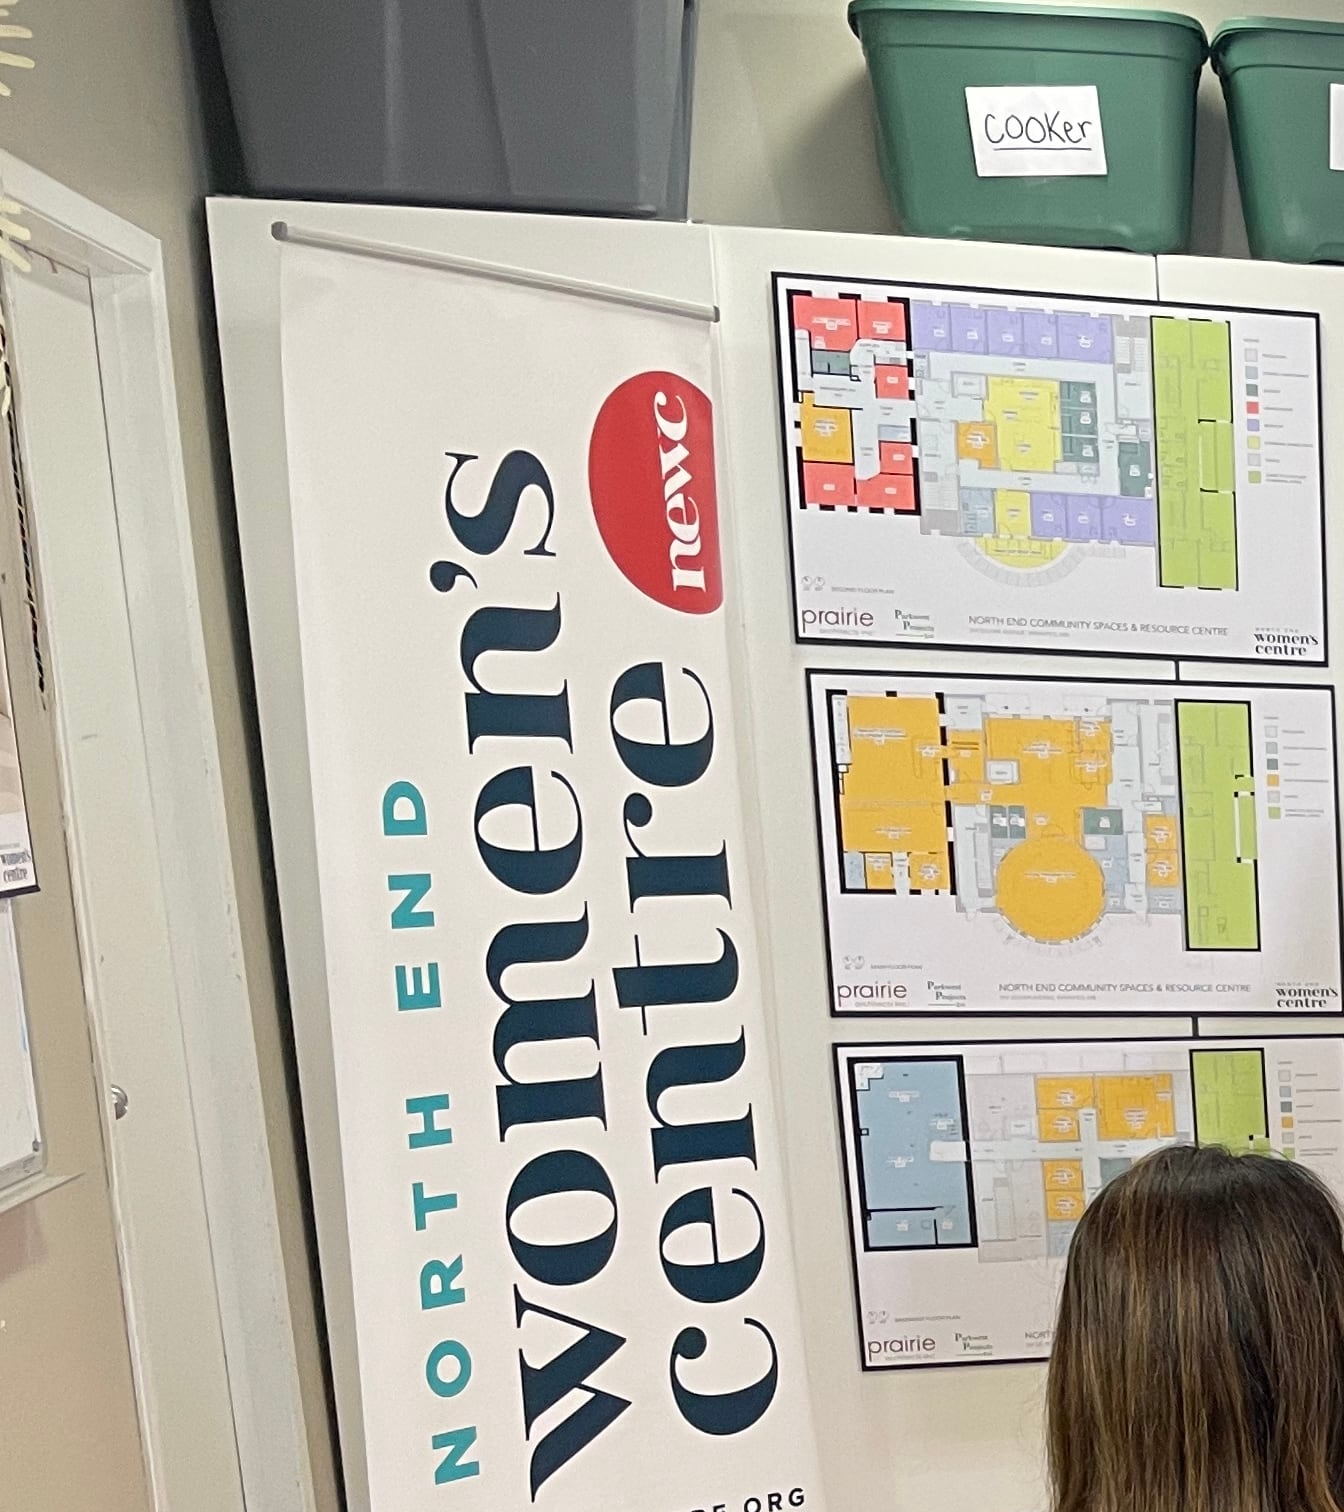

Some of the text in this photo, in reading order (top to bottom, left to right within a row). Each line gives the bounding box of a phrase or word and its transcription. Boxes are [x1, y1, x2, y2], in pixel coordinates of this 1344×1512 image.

[652, 390, 707, 593] newc
[801, 606, 874, 634] prairie
[969, 616, 1229, 636] NORTH END COMMUNITY SPACES & RESOURCE CENTRE
[1254, 633, 1319, 646] women's
[1255, 644, 1307, 656] centre
[429, 449, 632, 1503] women's
[837, 980, 908, 1008] prairie
[998, 983, 1251, 994] NORTH END COMMUNITY SPACES & RESOURCE CENTRE
[1275, 986, 1339, 999] women's
[1276, 997, 1327, 1009] centre
[609, 661, 779, 1436] centre
[382, 780, 480, 1486] NORTH END
[1025, 1330, 1051, 1339] NORT
[868, 1334, 936, 1362] prairie
